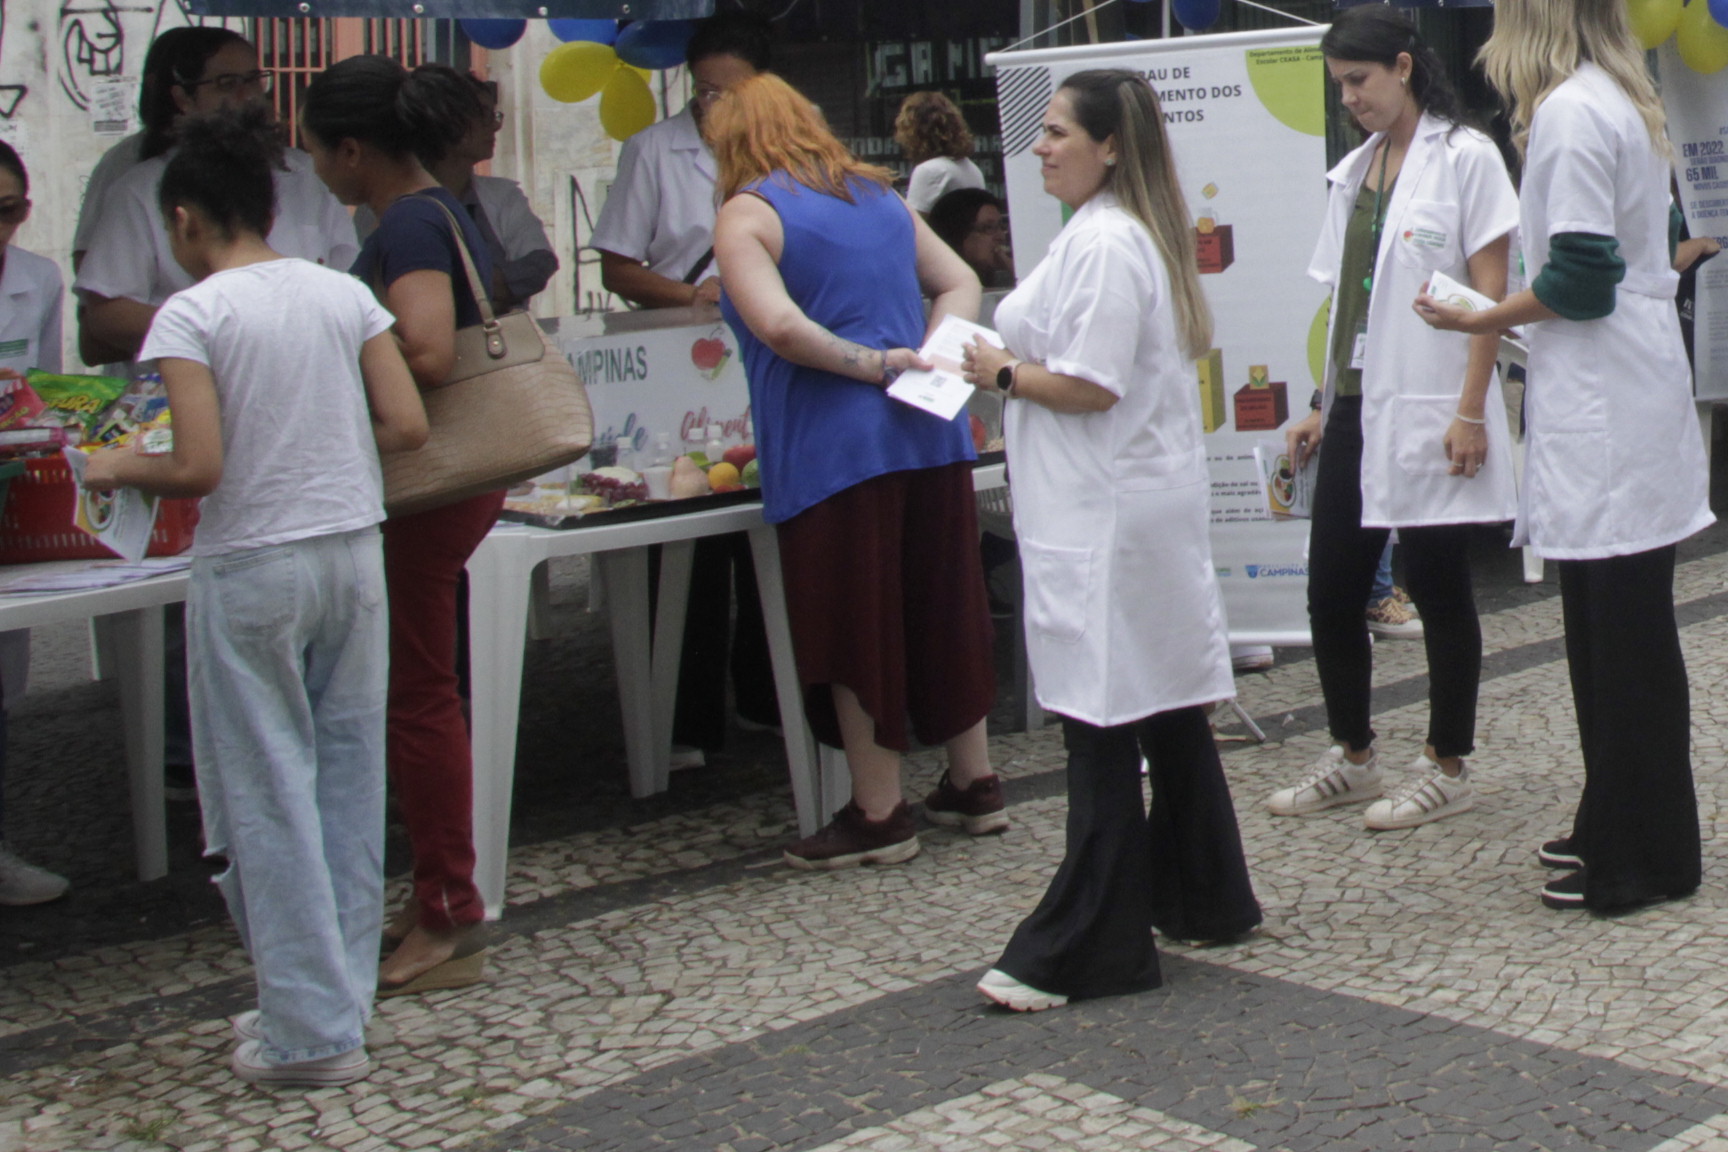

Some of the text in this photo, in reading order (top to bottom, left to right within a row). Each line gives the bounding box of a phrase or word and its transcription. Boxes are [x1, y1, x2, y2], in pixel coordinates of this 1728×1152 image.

[1139, 66, 1191, 81] RAU DE
[1211, 84, 1242, 99] DOS
[1682, 140, 1725, 158] EM 2022
[1686, 166, 1719, 182] 65 MIL
